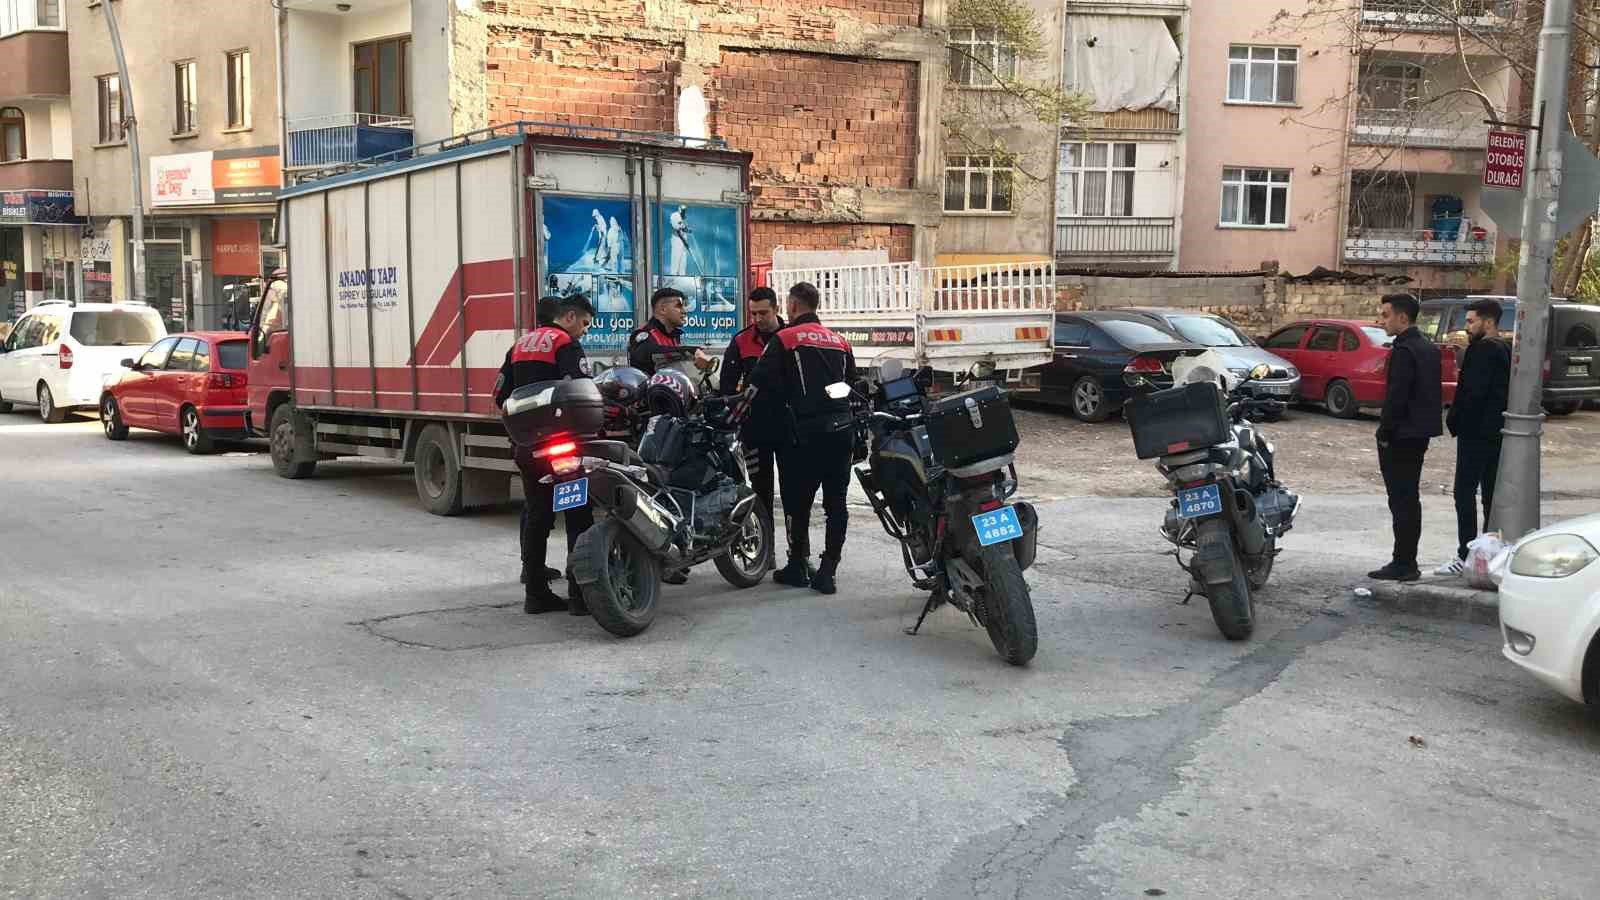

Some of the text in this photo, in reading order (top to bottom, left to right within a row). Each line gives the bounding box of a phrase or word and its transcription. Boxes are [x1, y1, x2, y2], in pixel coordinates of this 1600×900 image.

[1490, 135, 1525, 149] BELEDİYE
[1487, 152, 1523, 168] OTOBÜS
[1487, 169, 1521, 186] DURAĞI
[338, 266, 397, 287] ANADOU YAPI
[558, 483, 580, 495] 23 A
[1184, 489, 1211, 502] 23 A
[558, 493, 582, 505] 4872
[1186, 500, 1215, 513] 4870
[981, 513, 1009, 528] 23 A
